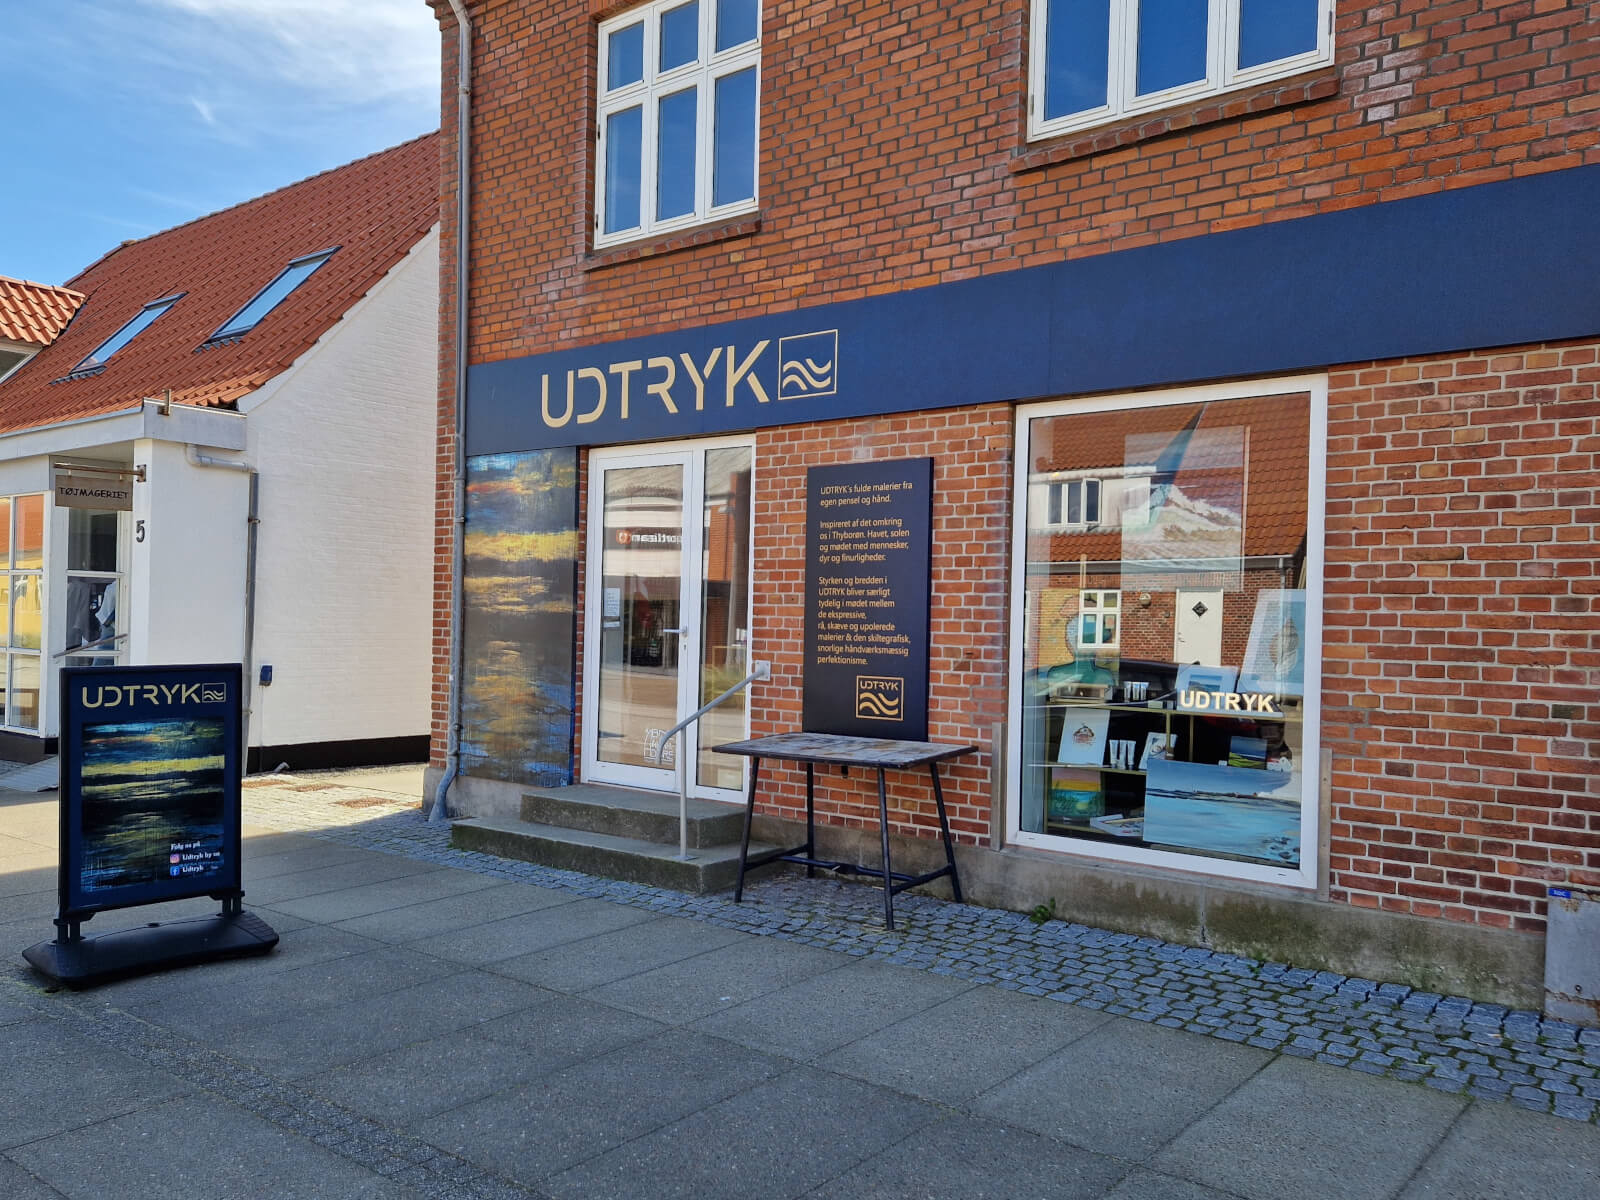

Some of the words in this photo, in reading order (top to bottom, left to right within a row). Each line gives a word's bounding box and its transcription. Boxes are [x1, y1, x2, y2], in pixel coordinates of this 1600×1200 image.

[541, 339, 770, 428] UDTRYK
[58, 487, 128, 499] TØJMAGERIET
[854, 484, 871, 492] fulde
[873, 483, 901, 491] malerier
[821, 499, 836, 508] egen
[838, 496, 859, 507] pensel
[872, 494, 891, 502] hånd.
[820, 520, 850, 530] Inspireret
[852, 519, 859, 527] af
[873, 518, 902, 527] omkring
[136, 520, 145, 542] 5
[833, 531, 865, 541] Thyborøn.
[820, 556, 830, 564] dyr
[819, 577, 843, 586] Styrken
[845, 577, 853, 587] og
[855, 576, 883, 584] bredden
[867, 588, 890, 598] særligt
[819, 600, 840, 609] tydelig
[828, 610, 867, 620] ekspressive,
[850, 623, 858, 631] og
[860, 622, 895, 632] upolerede
[818, 645, 843, 654] snorlige
[845, 645, 908, 657] håndværksmæssig
[817, 655, 868, 665] perfektionisme.
[860, 680, 898, 691] UDTRYK
[82, 683, 202, 708] UDTRYK
[1180, 690, 1274, 712] UDTRYK
